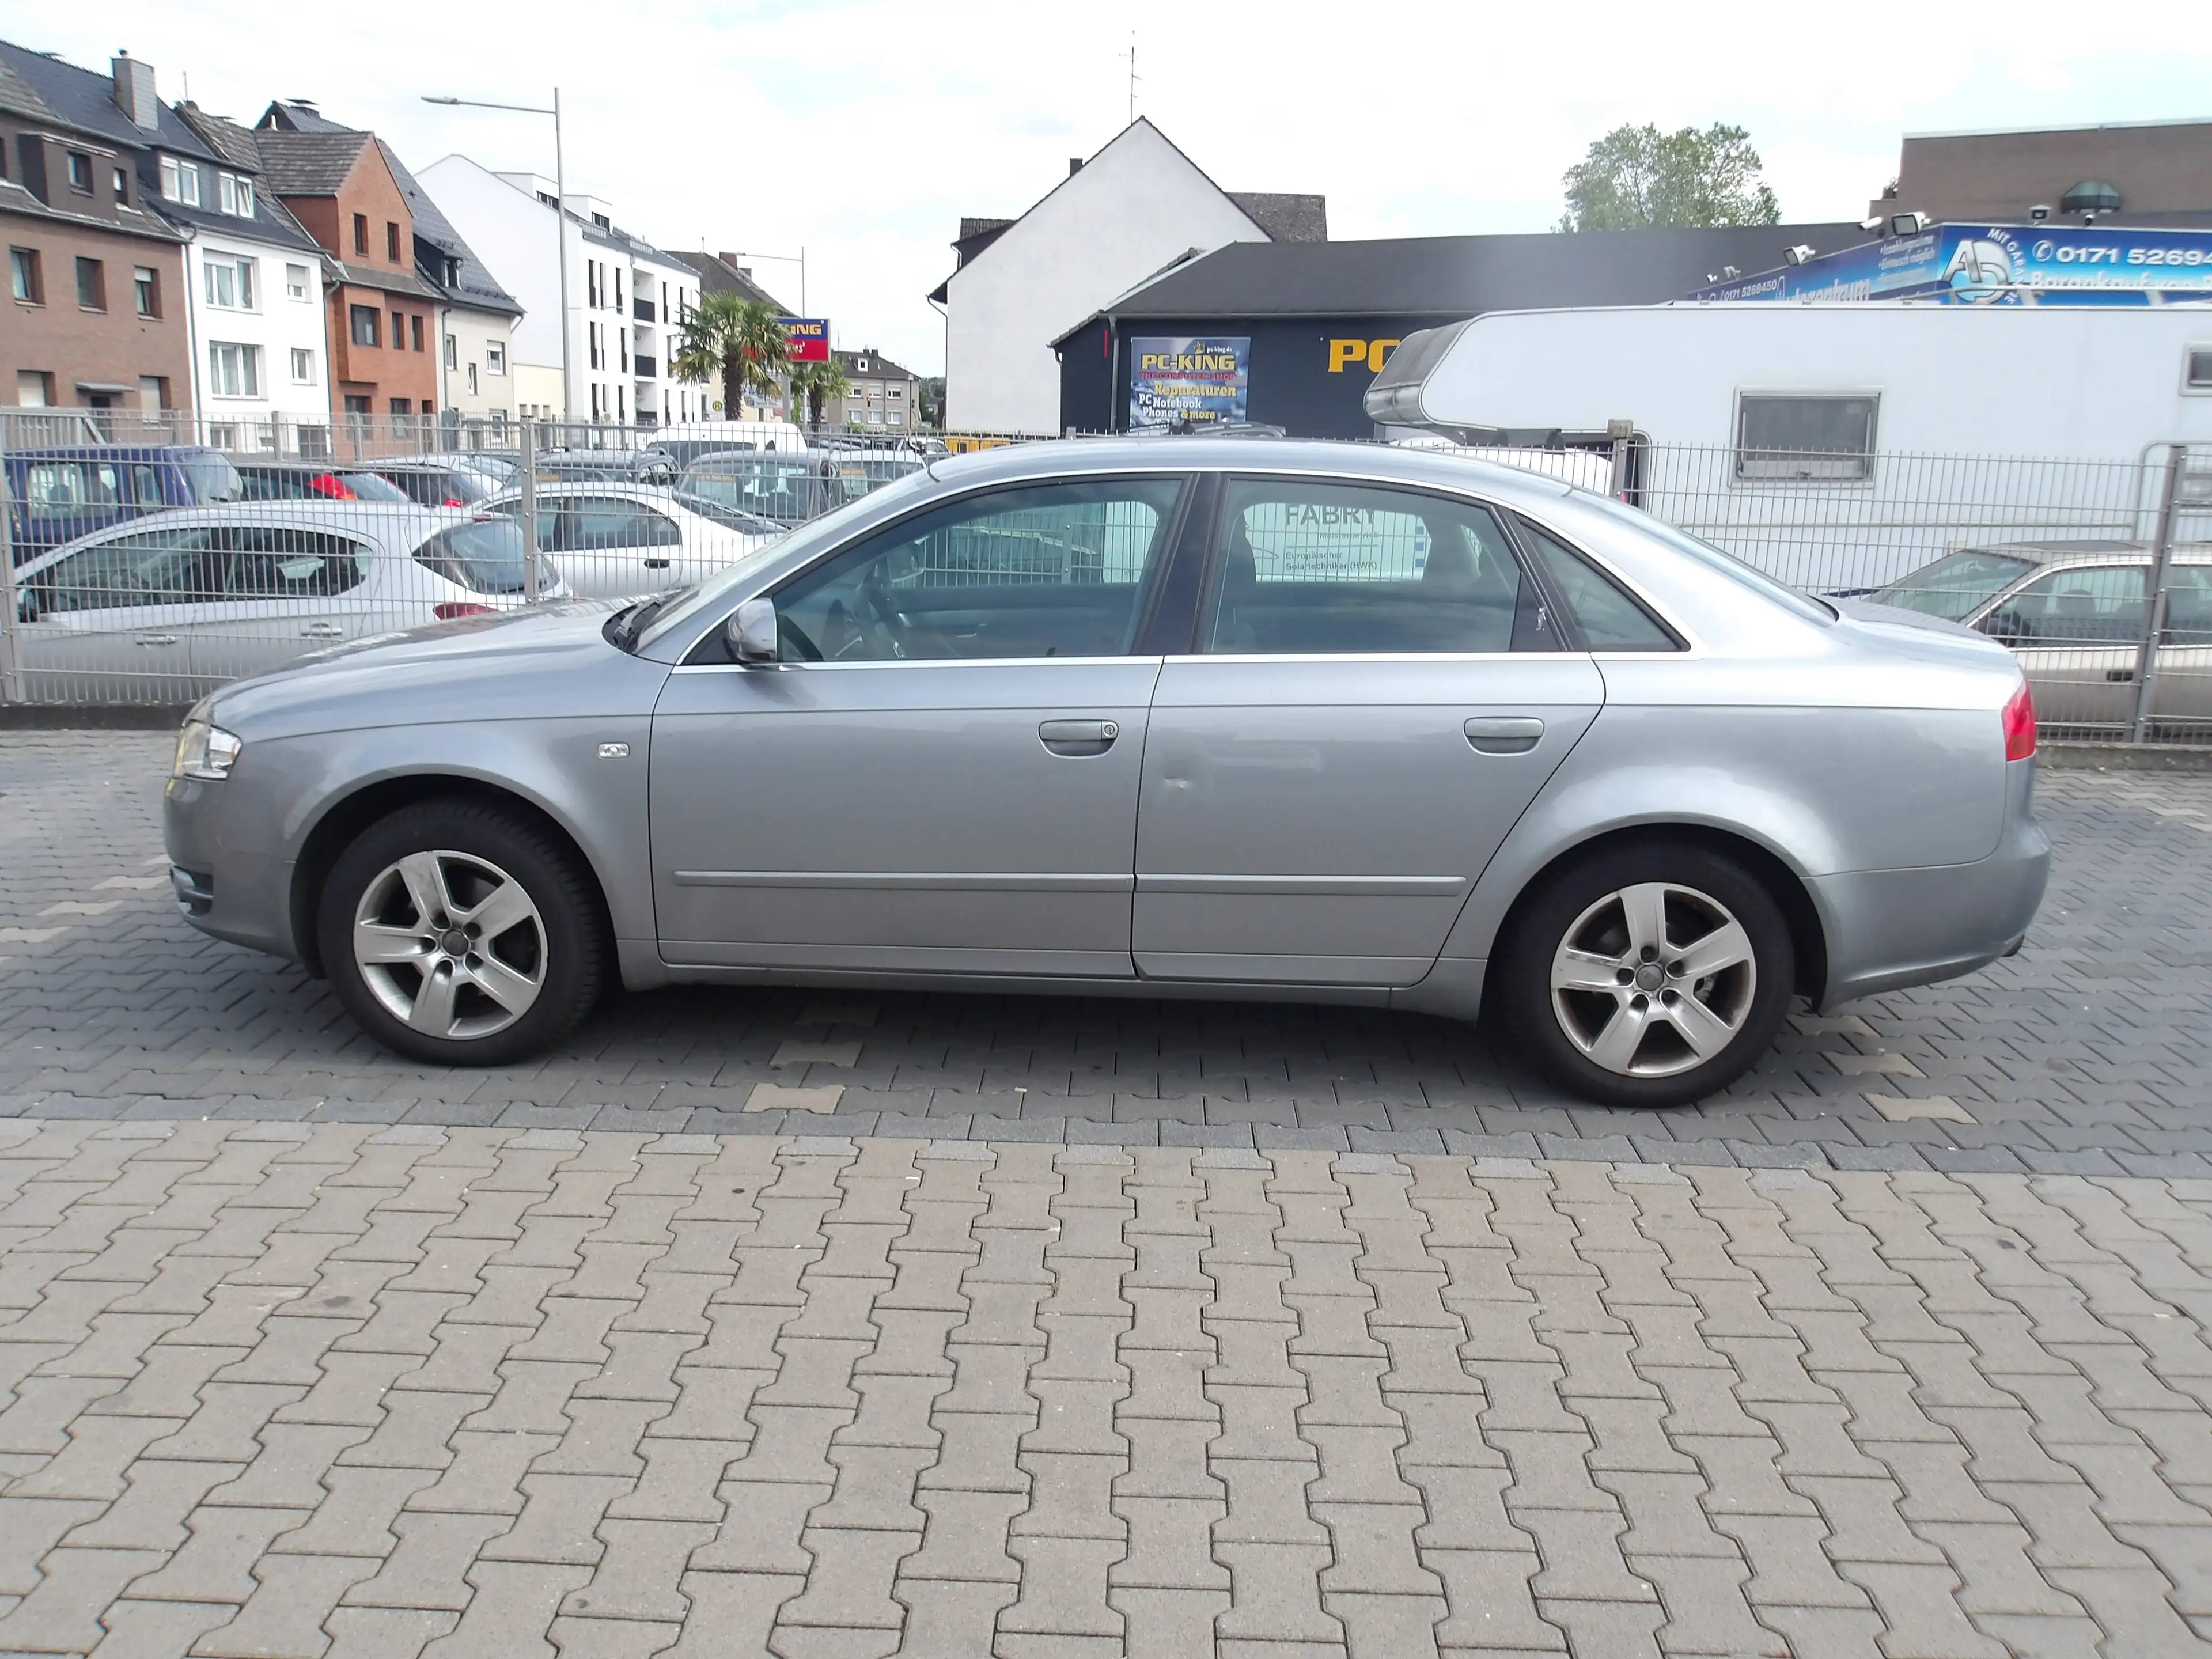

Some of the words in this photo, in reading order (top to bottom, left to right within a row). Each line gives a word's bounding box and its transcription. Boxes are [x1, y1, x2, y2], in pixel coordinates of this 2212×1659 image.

[2055, 247, 2119, 264] 0171
[1987, 228, 2010, 244] MIT
[2003, 241, 2026, 305] GARAIE
[1741, 278, 1778, 298] 5269450
[1141, 354, 1236, 370] PC-KING
[1160, 372, 1209, 381] COMPUTER
[1153, 381, 1237, 398] Reparaturen
[1138, 393, 1152, 404] PC
[1153, 396, 1202, 409] Notebook
[1142, 406, 1179, 419] Phones
[1285, 505, 1375, 525] FABRY
[1285, 562, 1347, 571] Solartechniker
